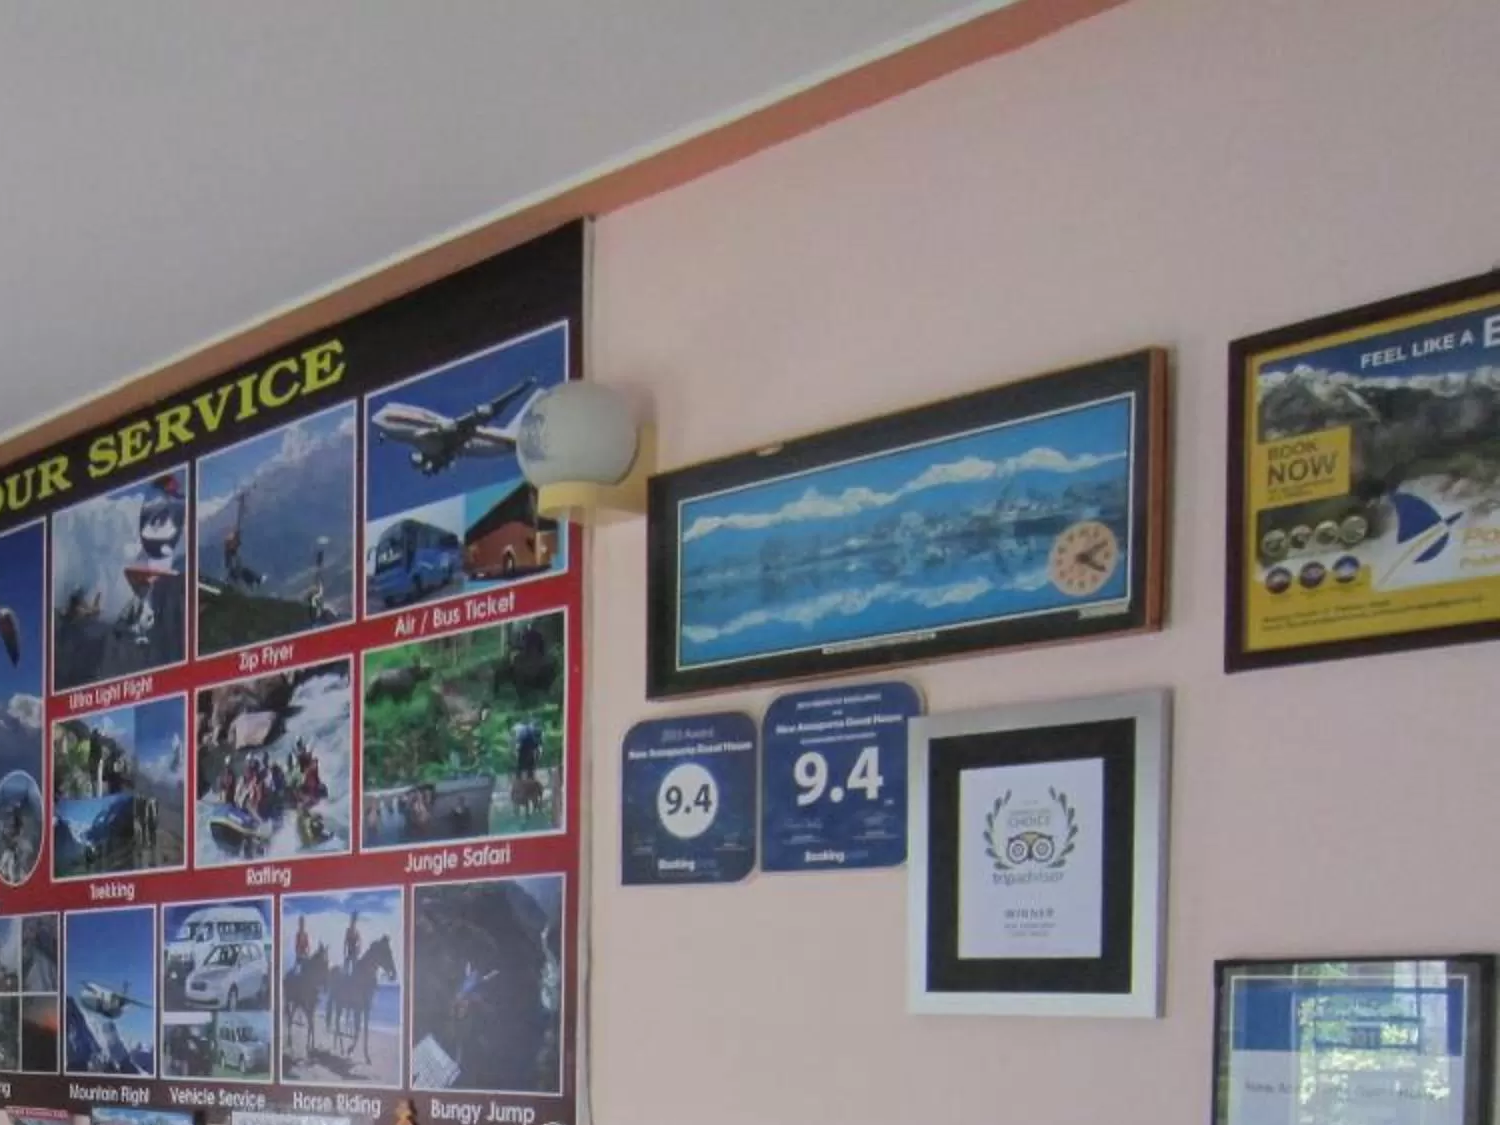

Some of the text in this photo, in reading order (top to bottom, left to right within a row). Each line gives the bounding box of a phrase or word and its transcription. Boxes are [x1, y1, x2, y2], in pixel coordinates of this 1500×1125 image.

[1360, 346, 1407, 369] FEEL
[1412, 333, 1456, 357] LIKE
[1460, 329, 1474, 346] A
[88, 339, 345, 478] SERVICE
[1267, 441, 1318, 461] BOOK
[1268, 453, 1338, 486] NOW
[394, 613, 415, 638] Air
[433, 607, 460, 629] Bus
[465, 590, 516, 621] Ticket
[238, 644, 295, 672] Zip Flyer
[95, 685, 121, 705] Light
[123, 677, 153, 700] Flight
[793, 746, 884, 807] 9.4
[665, 784, 713, 816] 9.4
[405, 844, 511, 876] Jungle Safari
[246, 865, 292, 888] Rafting
[89, 882, 135, 901] Trekking
[69, 1083, 149, 1106] Mountain Flight
[169, 1087, 266, 1109] Vehicle Service
[292, 1091, 381, 1118] Horse Riding
[431, 1099, 535, 1125] Bungy Jump
